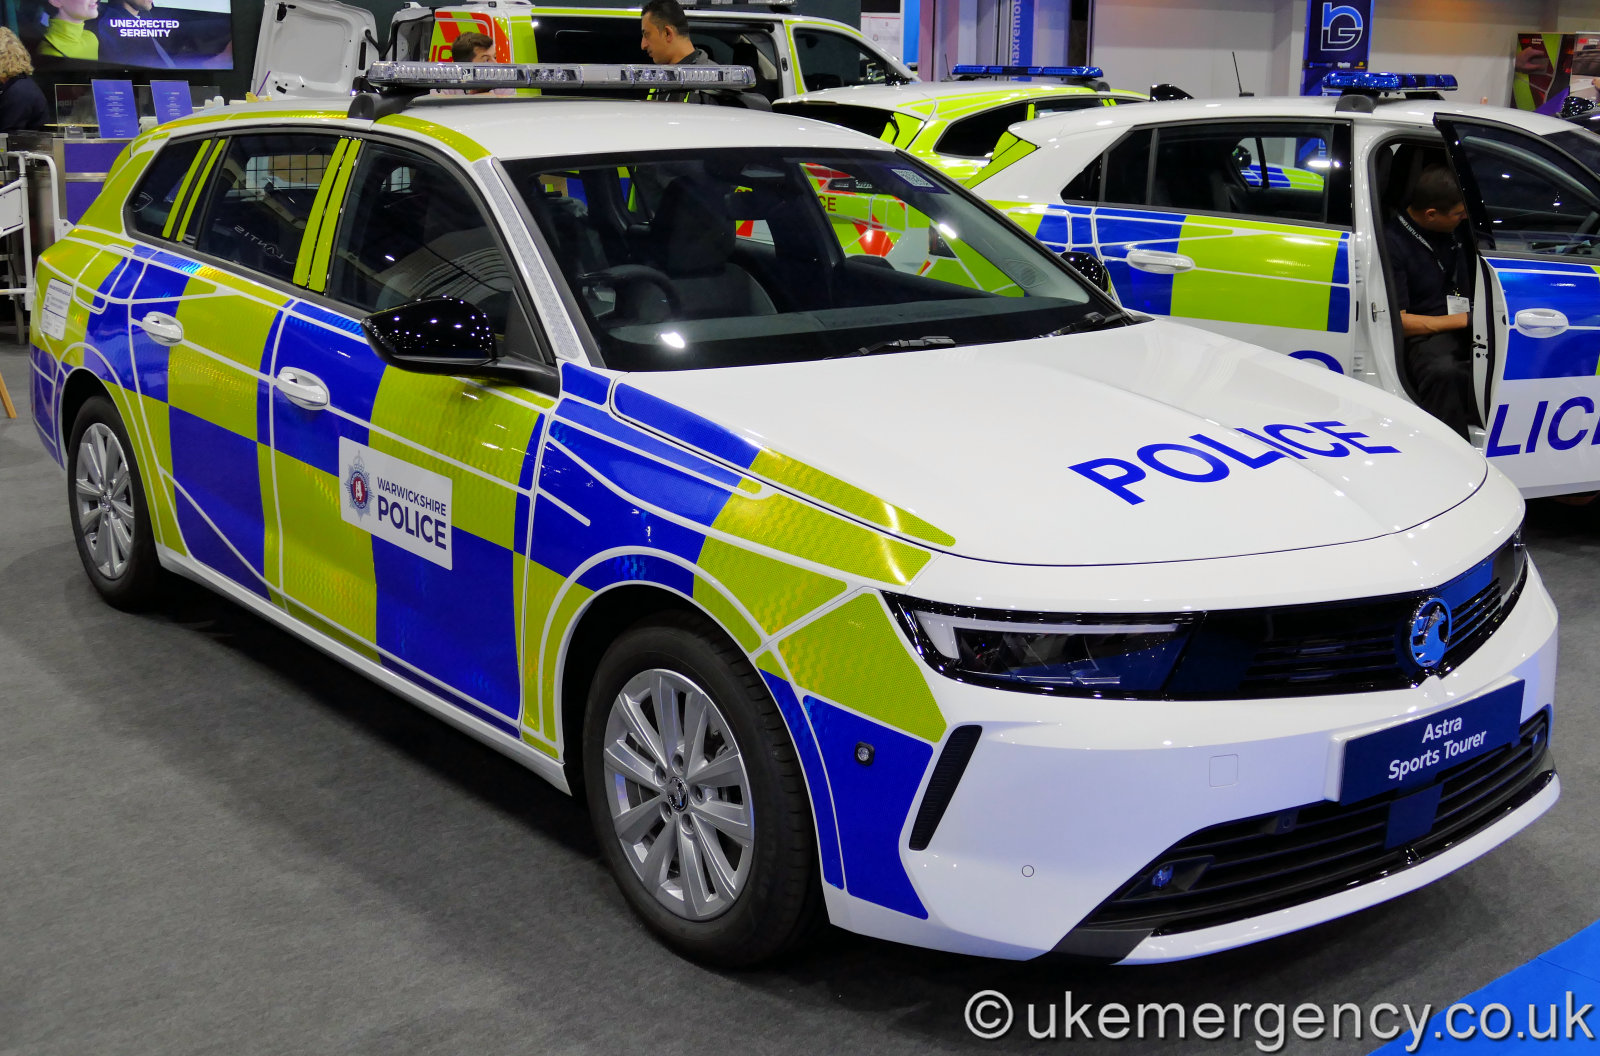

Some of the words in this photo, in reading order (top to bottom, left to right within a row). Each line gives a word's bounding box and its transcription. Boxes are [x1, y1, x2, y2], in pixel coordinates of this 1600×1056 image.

[109, 19, 180, 29] UNEXPECTED
[120, 28, 171, 38] SERENITY
[1067, 420, 1402, 506] POLICE
[377, 476, 447, 517] WARWICKSHIRE
[378, 494, 447, 551] POLICE
[1421, 716, 1463, 744] Astra
[1388, 749, 1440, 781] Sports
[1443, 730, 1487, 759] Tourer
